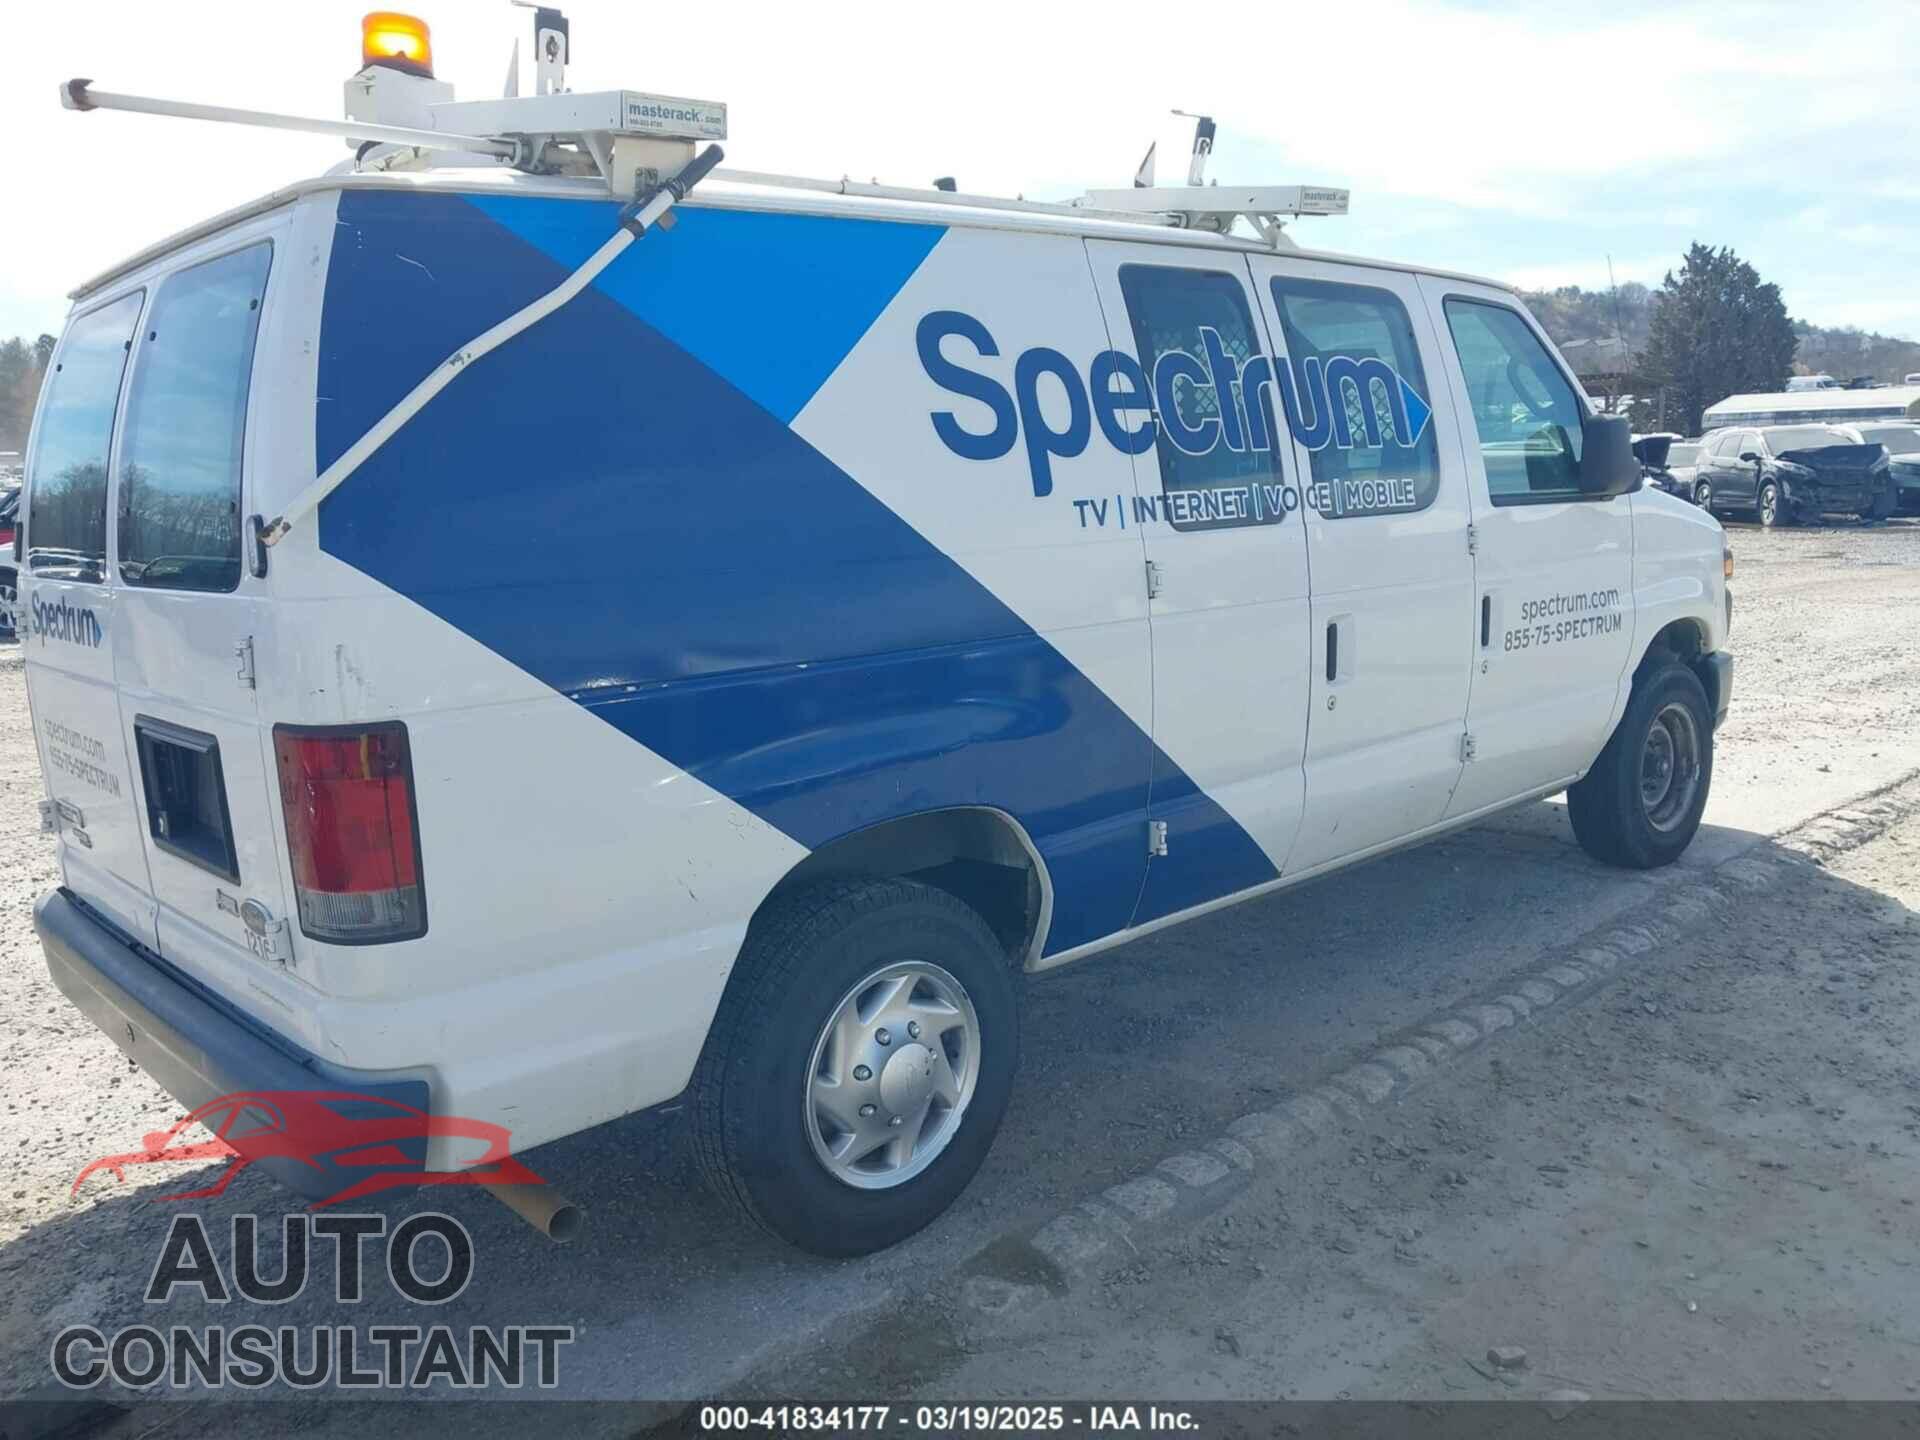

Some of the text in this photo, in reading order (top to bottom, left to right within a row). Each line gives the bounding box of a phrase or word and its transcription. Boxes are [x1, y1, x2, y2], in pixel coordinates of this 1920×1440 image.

[916, 310, 1414, 497] Spectrum
[1073, 499, 1109, 527] TV
[1132, 487, 1248, 523] INTERNET
[1345, 478, 1416, 508] MOBILE
[32, 590, 99, 648] Spectrum
[1521, 588, 1620, 624] spectrum.com
[1504, 613, 1622, 651] 855-75-SPECTRUM
